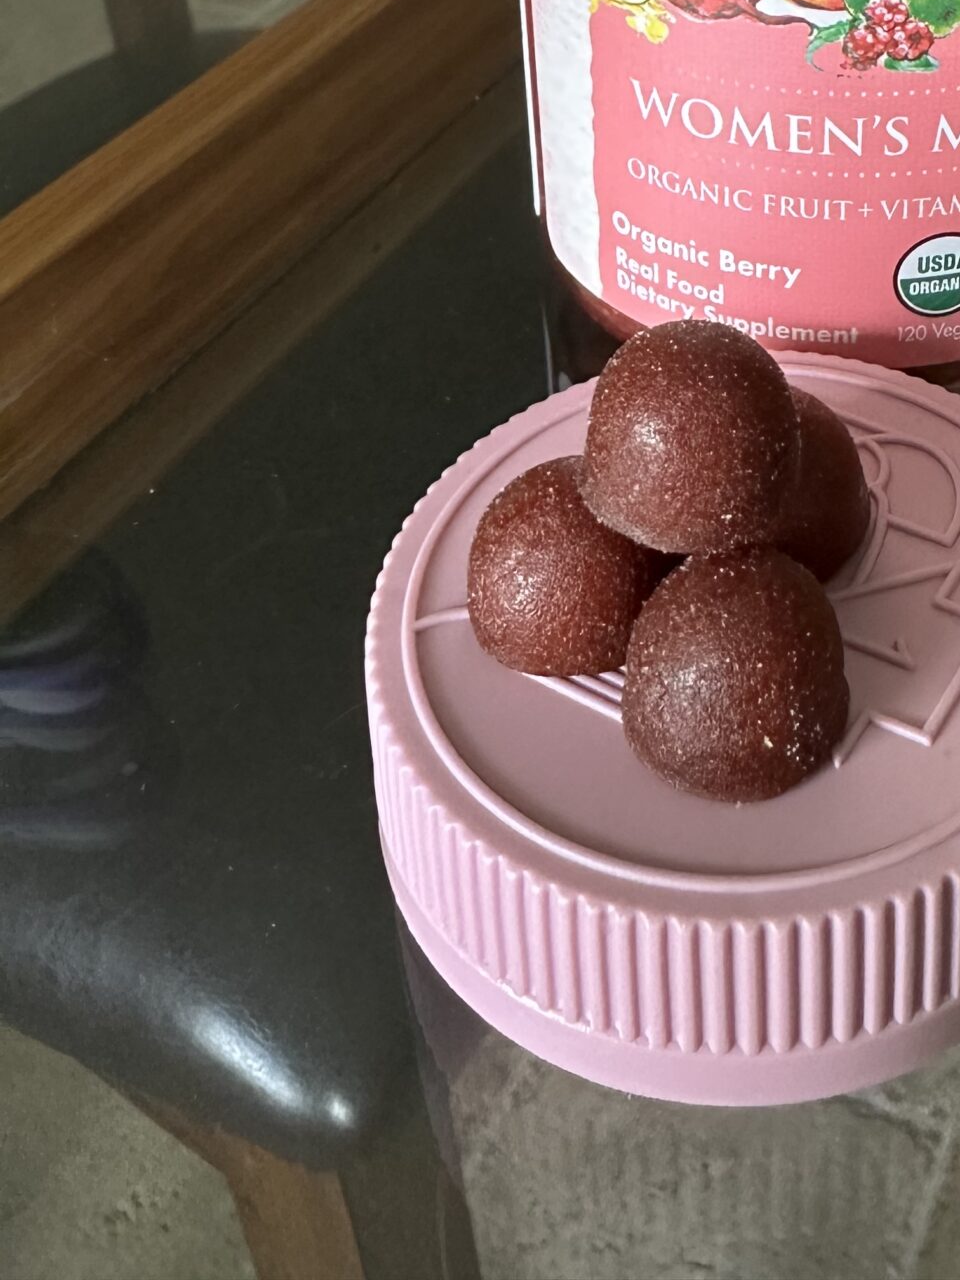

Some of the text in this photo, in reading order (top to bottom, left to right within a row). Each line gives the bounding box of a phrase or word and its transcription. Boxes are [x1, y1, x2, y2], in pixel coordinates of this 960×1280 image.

[629, 77, 910, 157] WOMEN'S
[627, 156, 752, 213] ORGANIC
[763, 193, 852, 221] FRUIT
[612, 210, 802, 289] Organic Berry
[616, 246, 724, 305] Real Food
[617, 269, 859, 344] Dietary Supplement
[897, 326, 927, 342] 120
